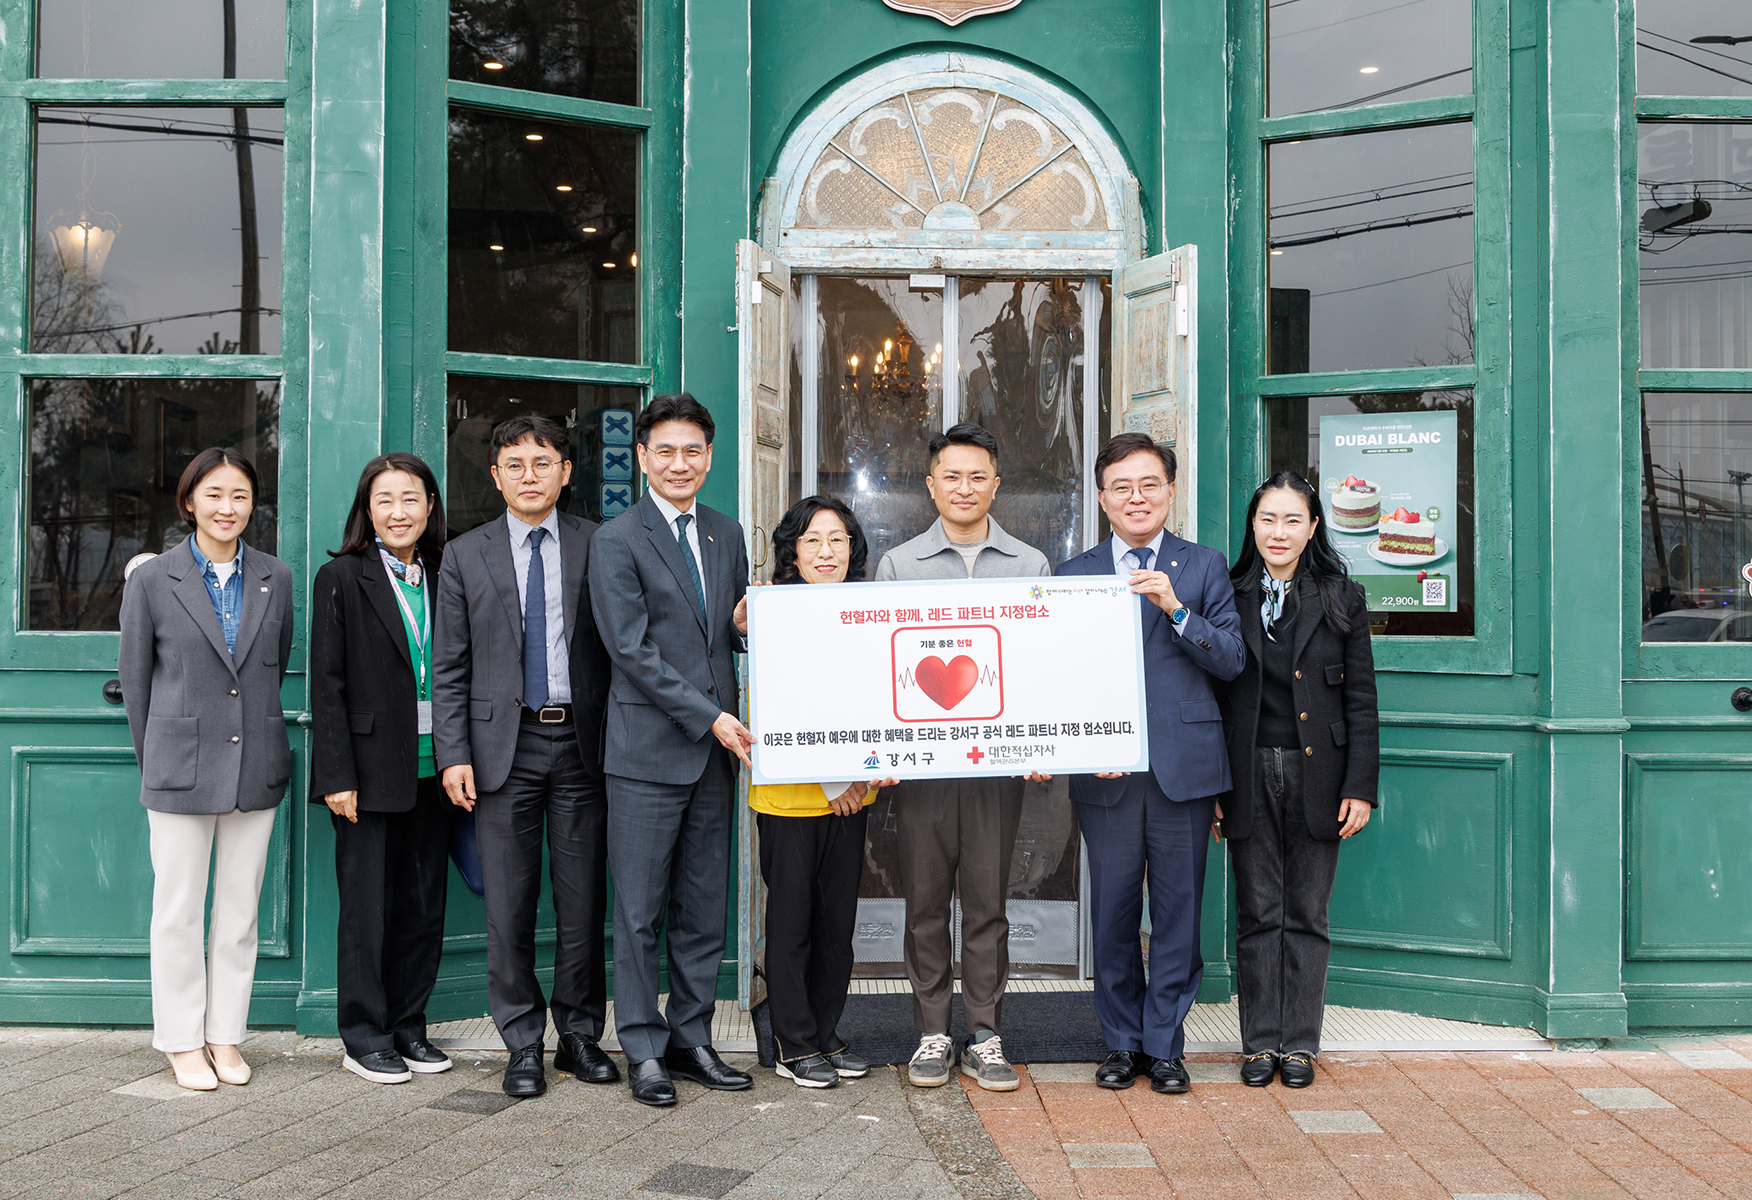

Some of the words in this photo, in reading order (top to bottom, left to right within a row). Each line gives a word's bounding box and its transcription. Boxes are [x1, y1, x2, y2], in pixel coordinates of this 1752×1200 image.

[1335, 433, 1382, 446] DUBAI
[1388, 432, 1441, 445] BLANC
[1109, 586, 1126, 597] 강서
[840, 608, 890, 624] 헌혈자와
[894, 607, 923, 623] 함께,
[928, 606, 953, 622] 레드
[957, 605, 995, 621] 파트너
[1000, 604, 1050, 619] 지정업소
[920, 639, 936, 649] 기분
[938, 639, 954, 648] 좋은
[956, 638, 972, 648] 헌혈
[764, 732, 793, 746] 이곳은
[797, 731, 826, 745] 헌혈자
[829, 730, 858, 744] 예우에
[862, 730, 881, 743] 대한
[884, 728, 914, 743] 혜택을
[917, 728, 947, 741] 드리는
[949, 726, 979, 741] 강서구
[982, 725, 1002, 740] 공식
[1005, 724, 1025, 738] 레드
[1028, 723, 1058, 738] 파트너
[1060, 722, 1080, 736] 지정
[1083, 721, 1134, 736] 업소입니다.
[989, 745, 1055, 758] 대한적십자사
